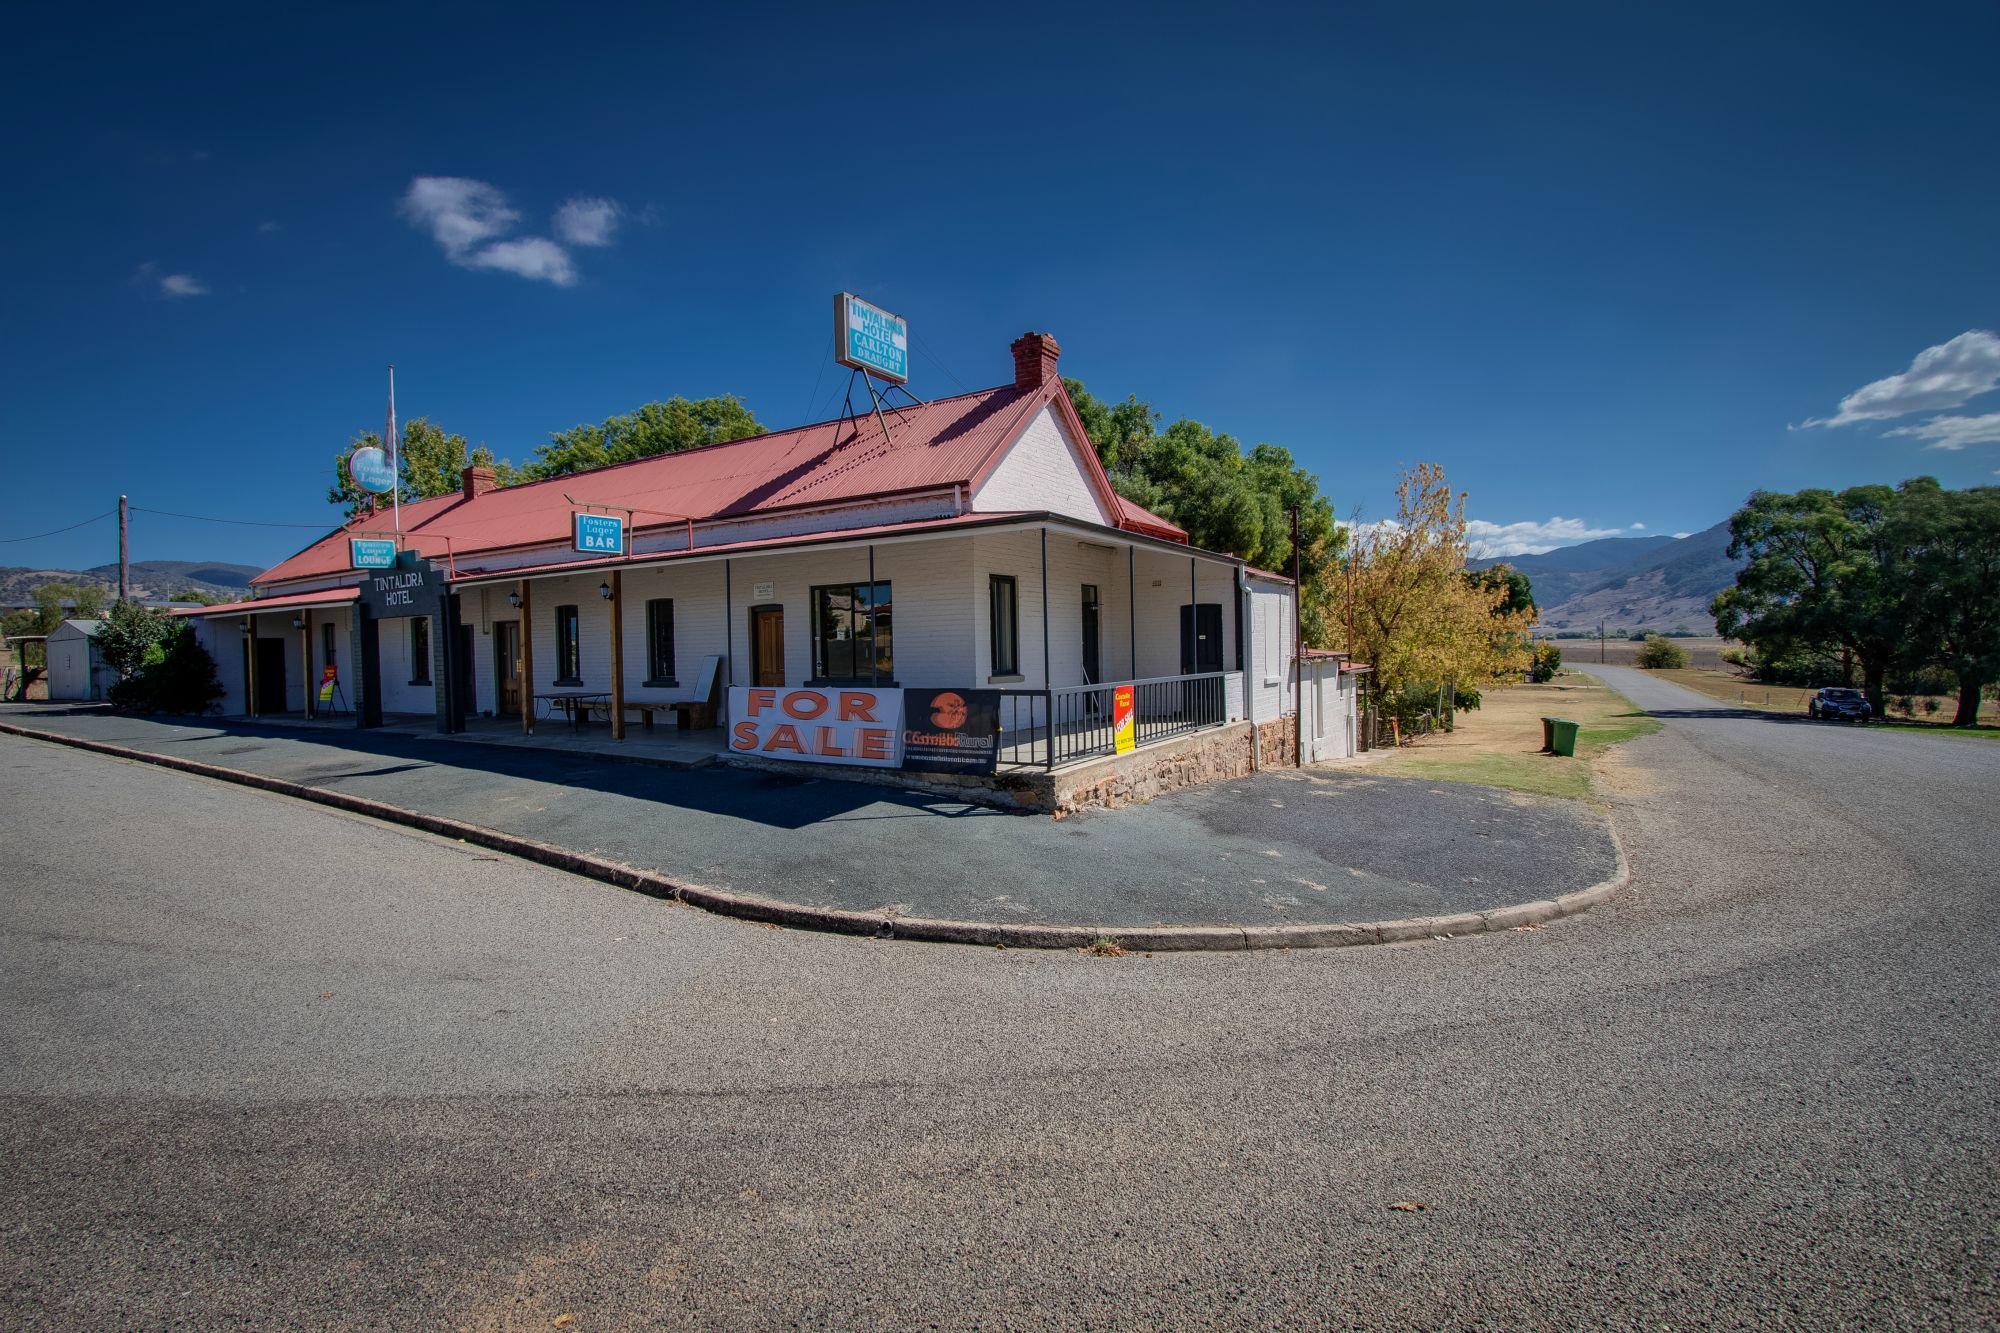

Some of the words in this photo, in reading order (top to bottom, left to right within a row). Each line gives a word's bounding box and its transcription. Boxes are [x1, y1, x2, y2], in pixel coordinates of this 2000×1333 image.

[851, 302, 904, 337] TINTALDRA
[862, 320, 896, 345] HOTEL
[854, 332, 903, 362] CARLTON
[857, 346, 901, 372] DRAUGHT
[583, 516, 617, 527] Fosters
[586, 525, 614, 536] Lager
[585, 535, 615, 548] BAR
[358, 555, 392, 565] LOUNGE
[374, 572, 424, 592] TINTALDRA
[386, 590, 413, 606] HOTEL
[747, 688, 880, 722] FOR
[731, 721, 896, 760] SALE
